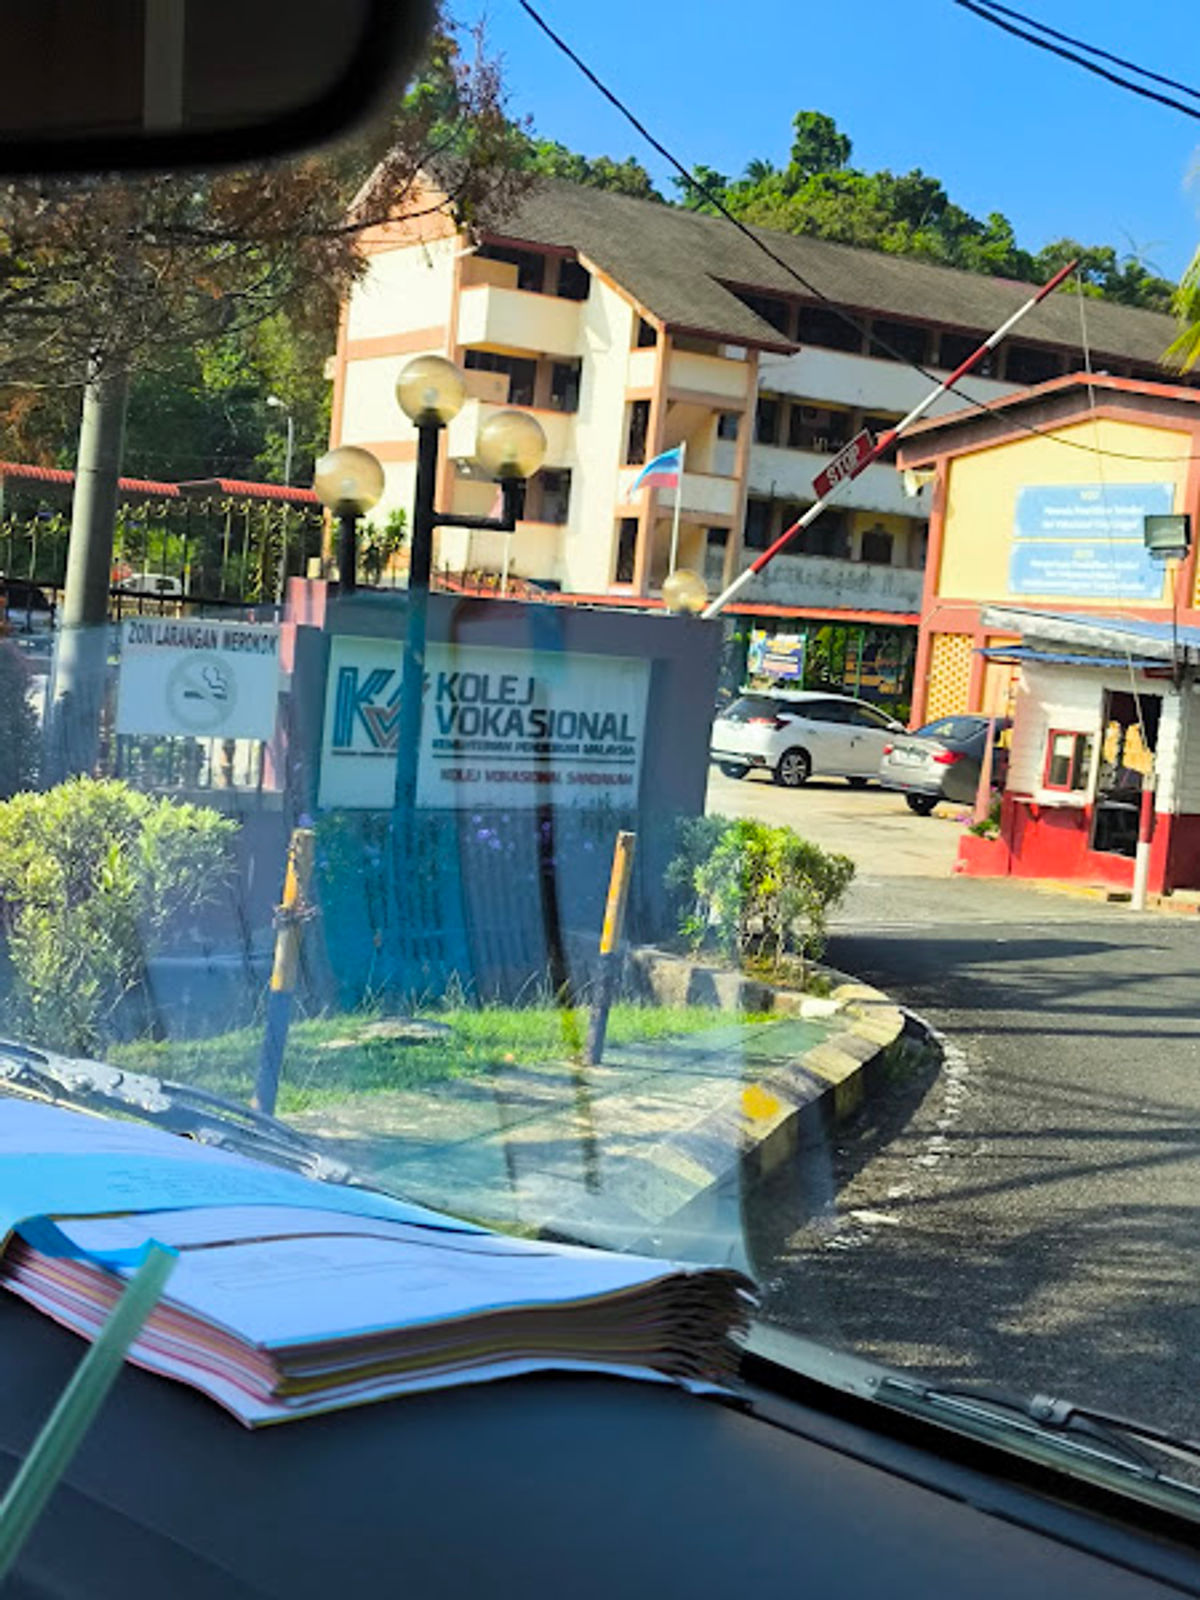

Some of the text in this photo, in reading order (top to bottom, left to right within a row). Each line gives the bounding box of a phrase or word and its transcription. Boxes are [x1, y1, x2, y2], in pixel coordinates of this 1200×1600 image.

[826, 443, 860, 485] STOP
[128, 622, 279, 655] ZON LARANGAN MEROKOK
[436, 672, 535, 704] KOLEJ
[435, 704, 636, 742] VOKASIONAL
